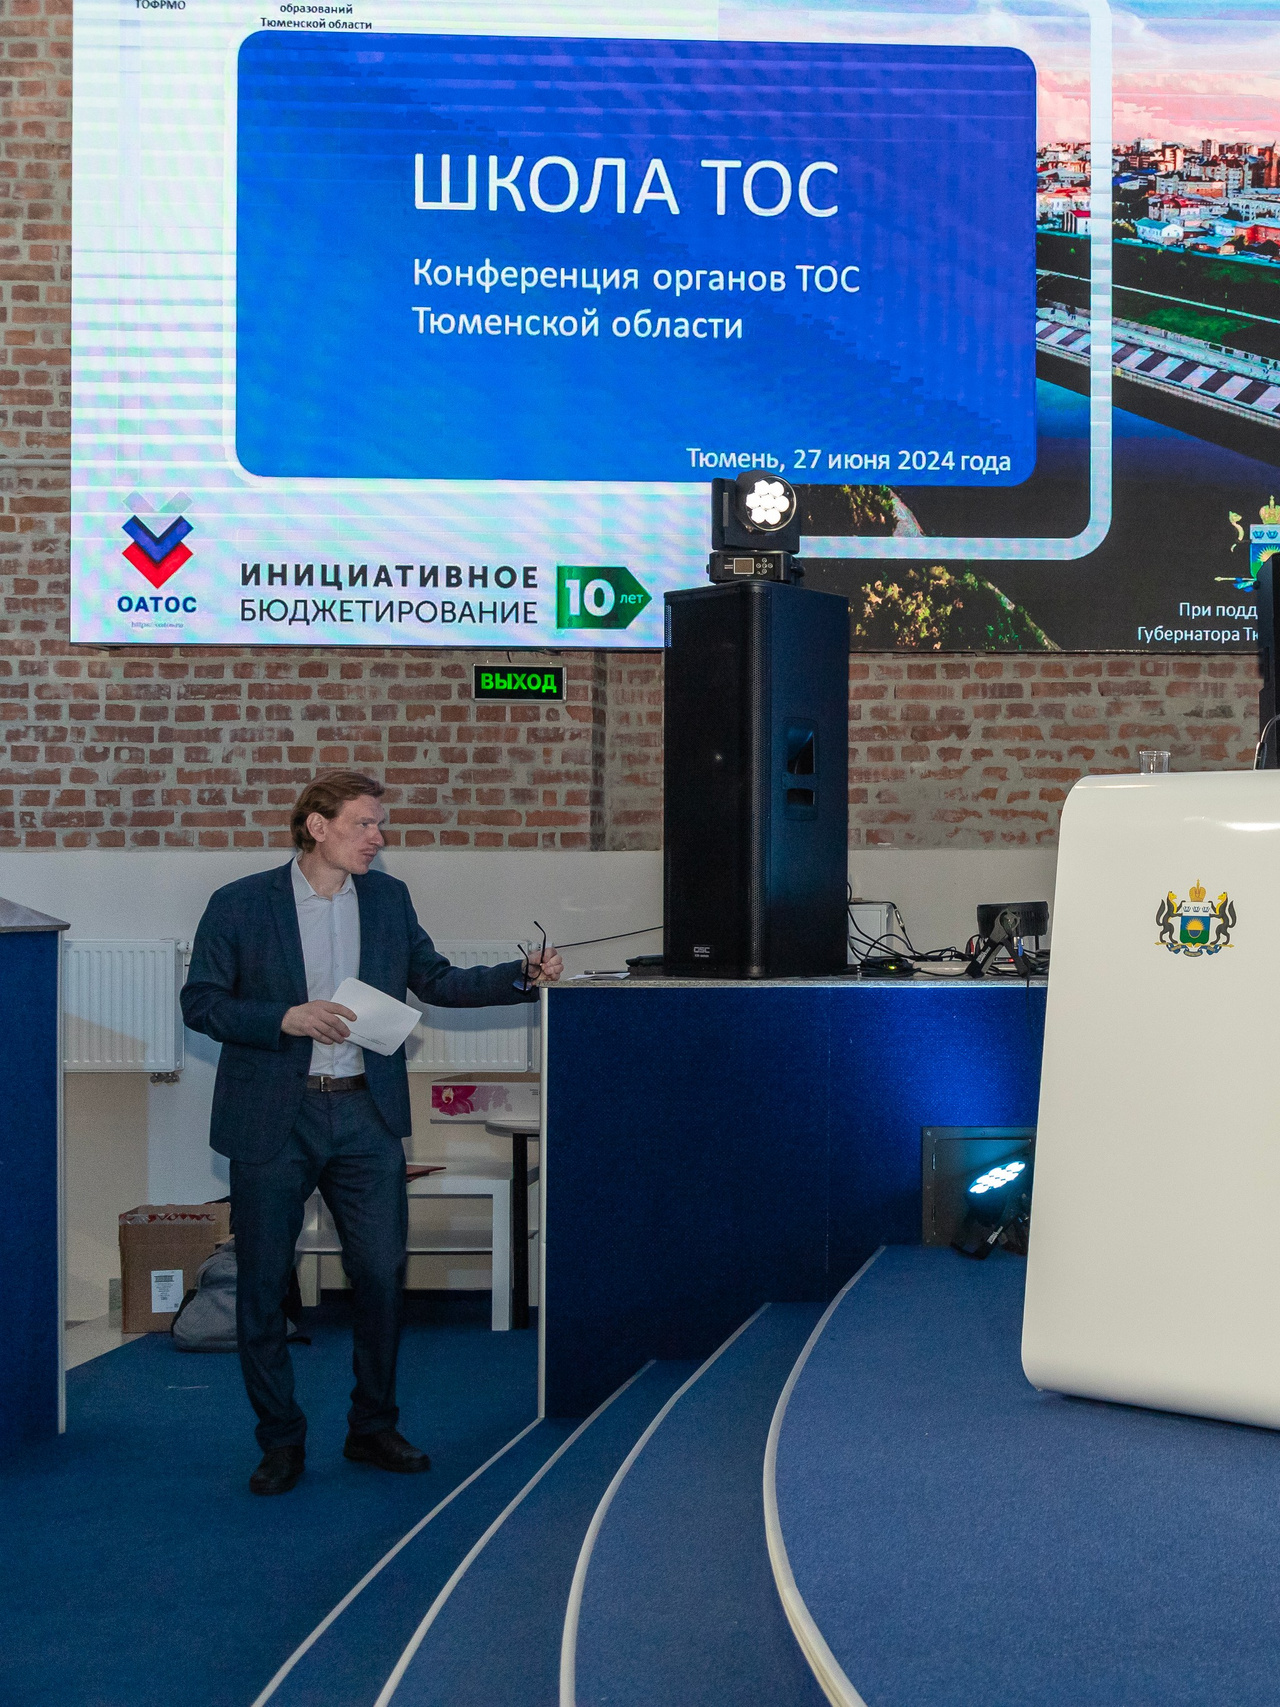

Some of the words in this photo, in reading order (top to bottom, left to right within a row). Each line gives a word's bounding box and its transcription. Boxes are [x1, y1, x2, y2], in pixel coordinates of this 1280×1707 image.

[280, 4, 353, 14] образований
[261, 17, 326, 29] Тюменской
[328, 19, 373, 30] области
[414, 153, 680, 215] ШКОЛА
[701, 158, 839, 219] ТОС
[413, 257, 640, 296] Конференция
[653, 268, 787, 299] органов
[795, 264, 861, 294] ТОС
[412, 305, 600, 338] Тюменской
[611, 308, 744, 340] области
[686, 447, 786, 474] Тюмень,
[793, 449, 823, 470] 27
[828, 453, 891, 471] июня
[897, 450, 957, 472] 2024
[961, 455, 1012, 475] года
[241, 563, 538, 592] ИНИЦИАТИВНОЕ
[117, 596, 197, 613] ОАТОС
[240, 598, 538, 625] БЮДЖЕТИРОВАНИЕ
[564, 579, 615, 617] 10
[619, 593, 644, 605] лет
[1179, 602, 1212, 620] При
[1137, 625, 1240, 646] Губернатора
[481, 673, 558, 695] ВЫХОД
